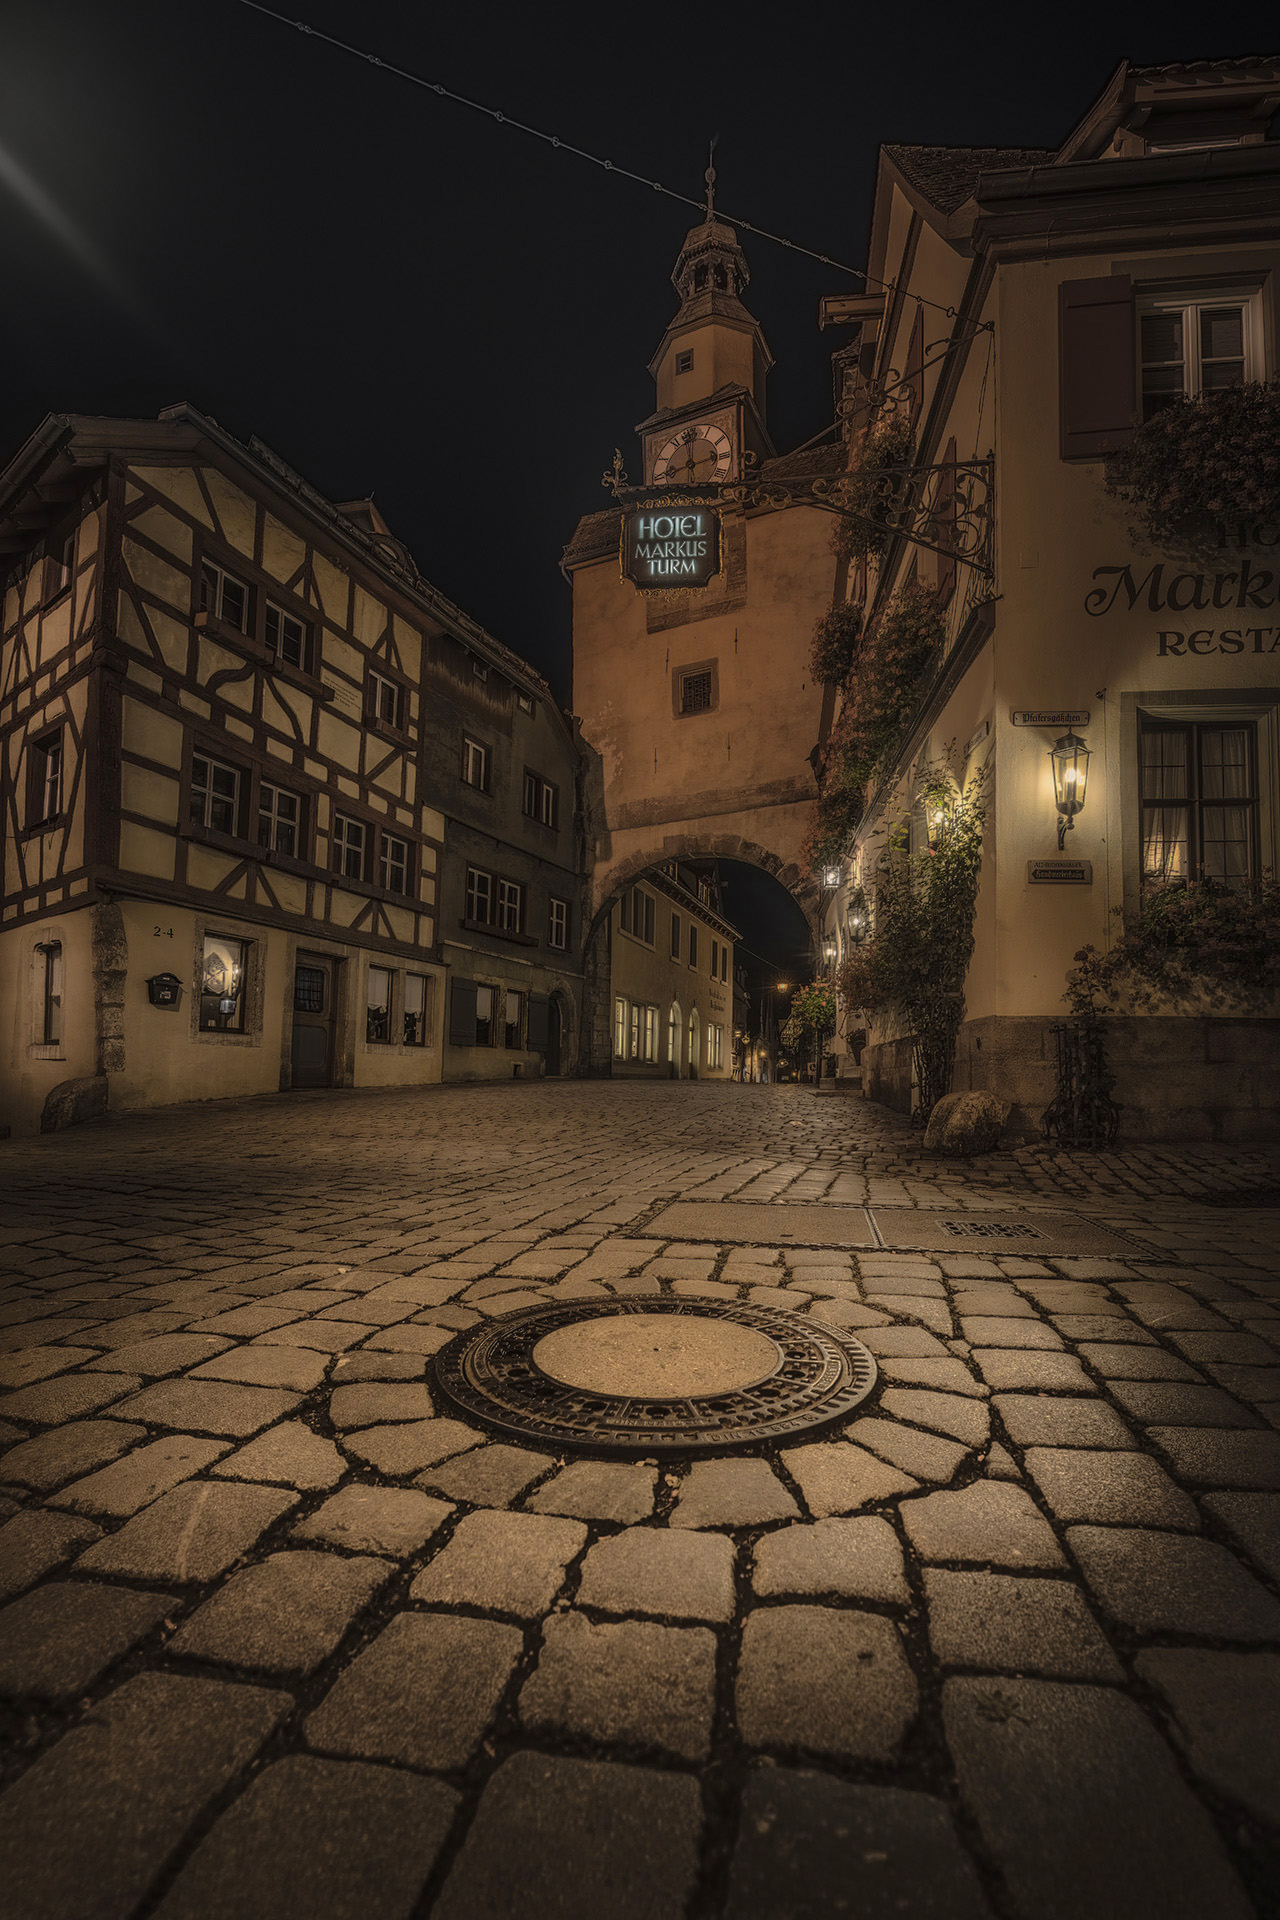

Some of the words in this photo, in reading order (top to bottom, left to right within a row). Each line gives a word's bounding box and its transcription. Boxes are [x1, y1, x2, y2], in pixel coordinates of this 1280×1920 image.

[638, 514, 707, 539] HOTEL
[634, 540, 707, 560] MARKUS
[646, 558, 697, 576] TURM
[1084, 559, 1280, 617] Mark
